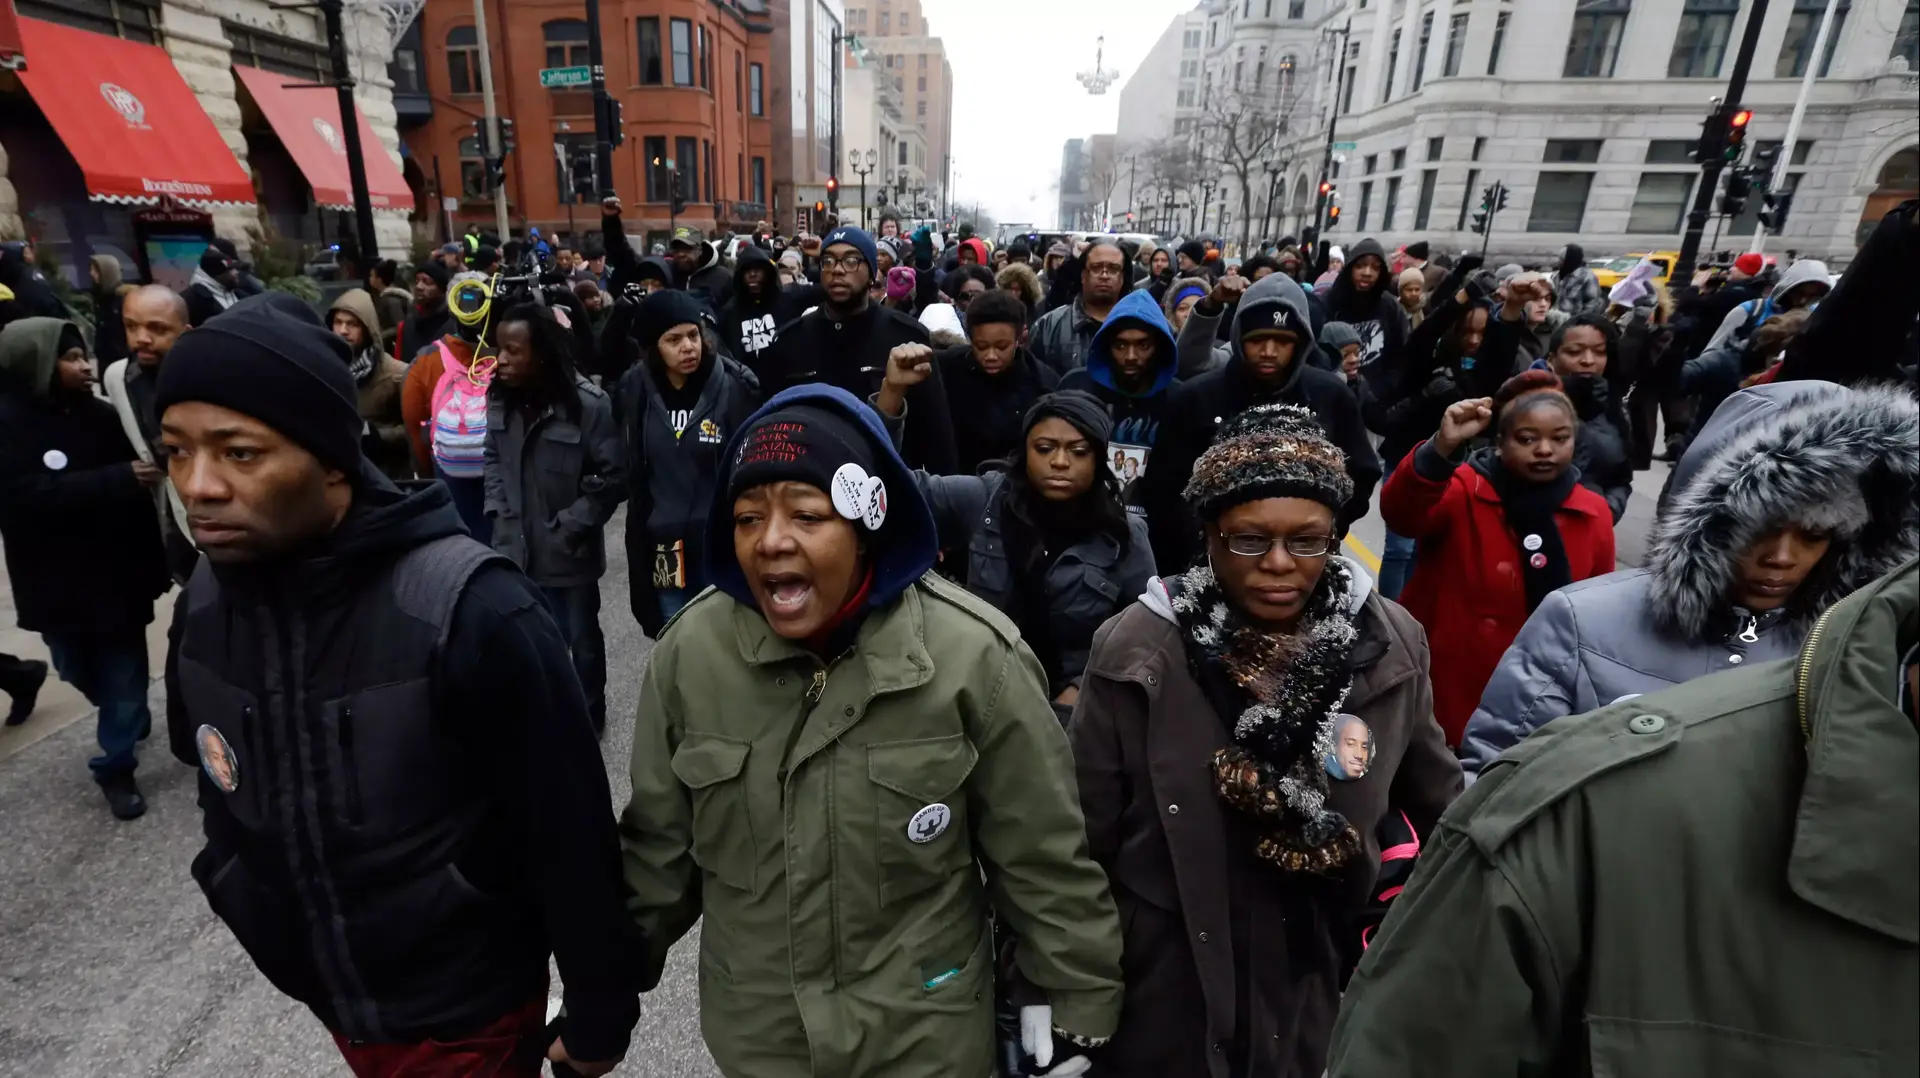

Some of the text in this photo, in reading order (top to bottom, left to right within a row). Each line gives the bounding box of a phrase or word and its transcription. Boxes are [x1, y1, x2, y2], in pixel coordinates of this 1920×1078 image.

[1273, 311, 1288, 326] M
[839, 471, 863, 516] DONTRE
[850, 480, 861, 498] AM
[870, 489, 881, 520] MY
[914, 806, 936, 822] HANDS
